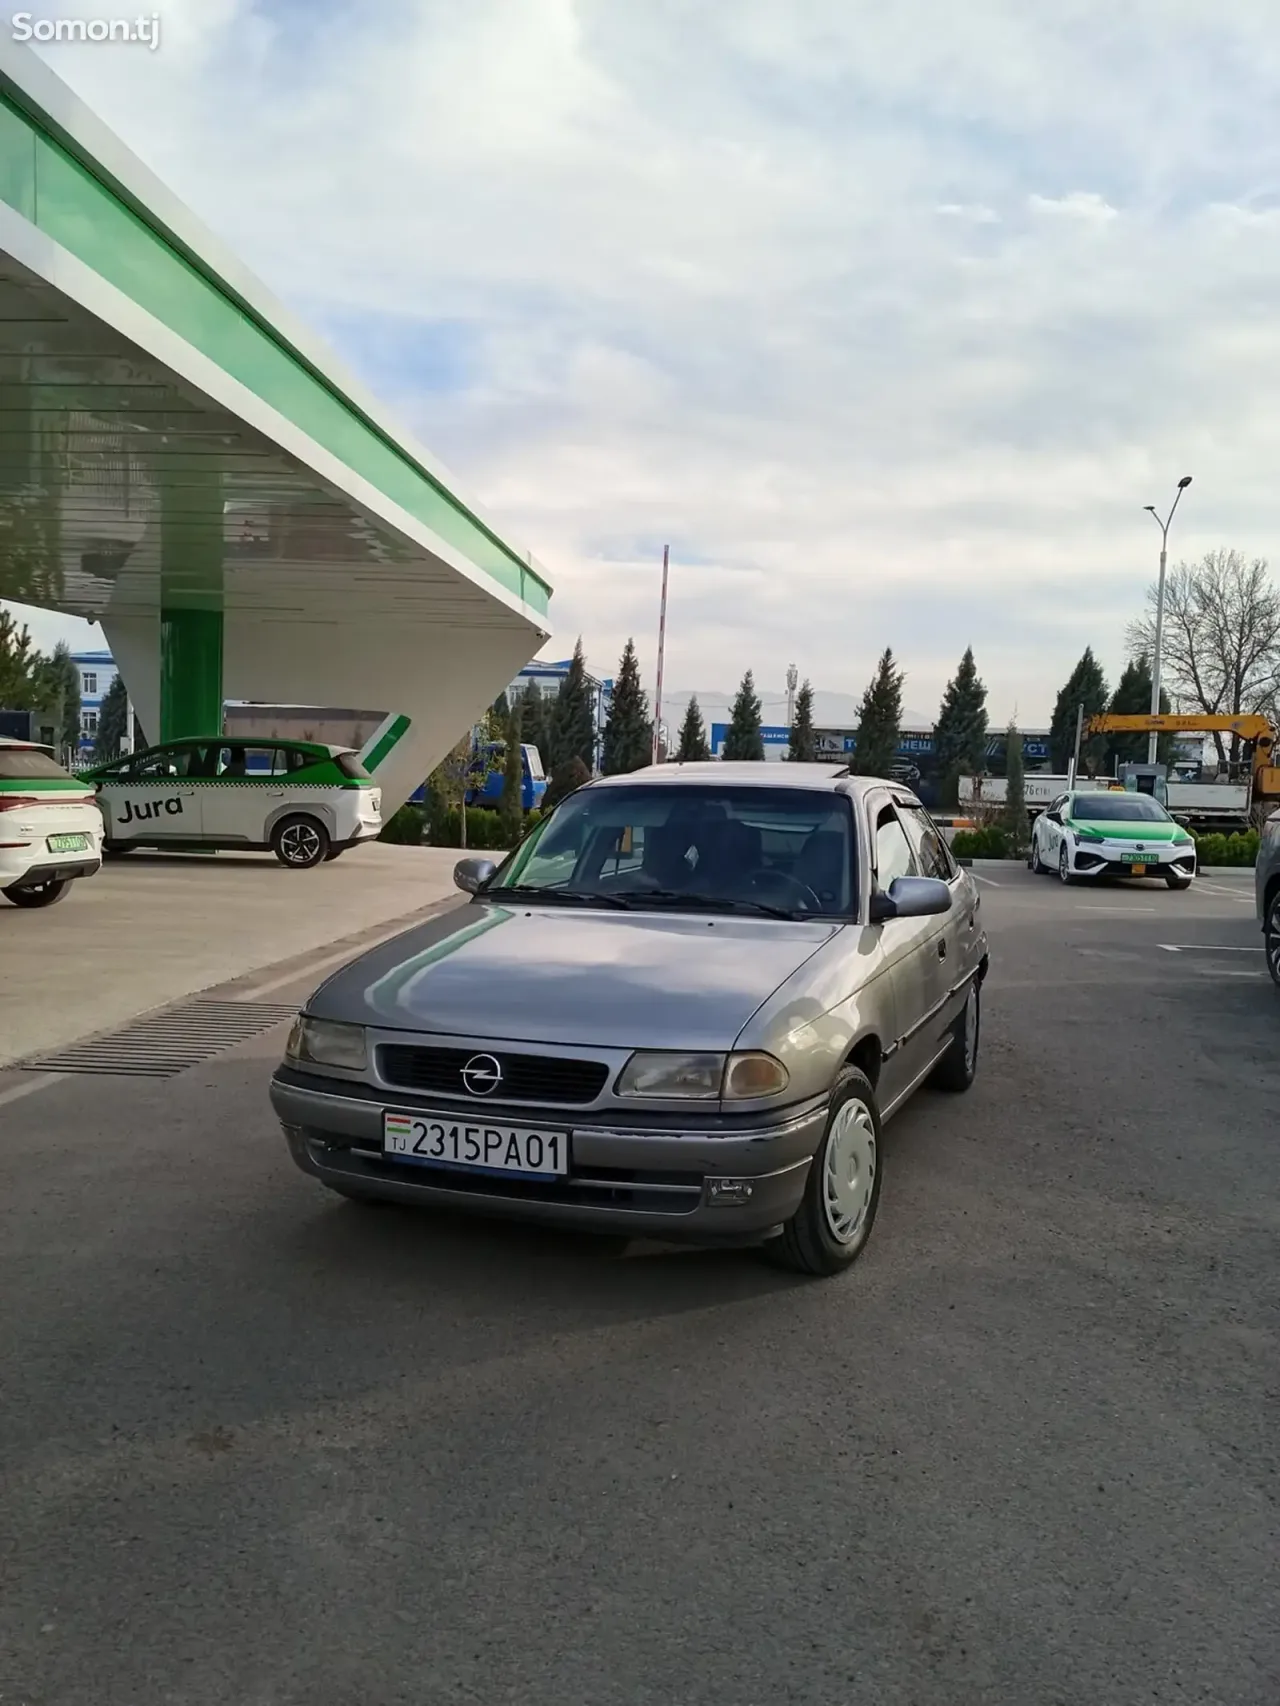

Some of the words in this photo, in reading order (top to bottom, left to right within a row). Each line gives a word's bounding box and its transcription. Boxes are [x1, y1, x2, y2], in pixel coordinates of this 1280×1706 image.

[117, 797, 184, 824] Jura
[392, 1137, 407, 1151] TJ
[412, 1121, 558, 1170] 2315PA01
